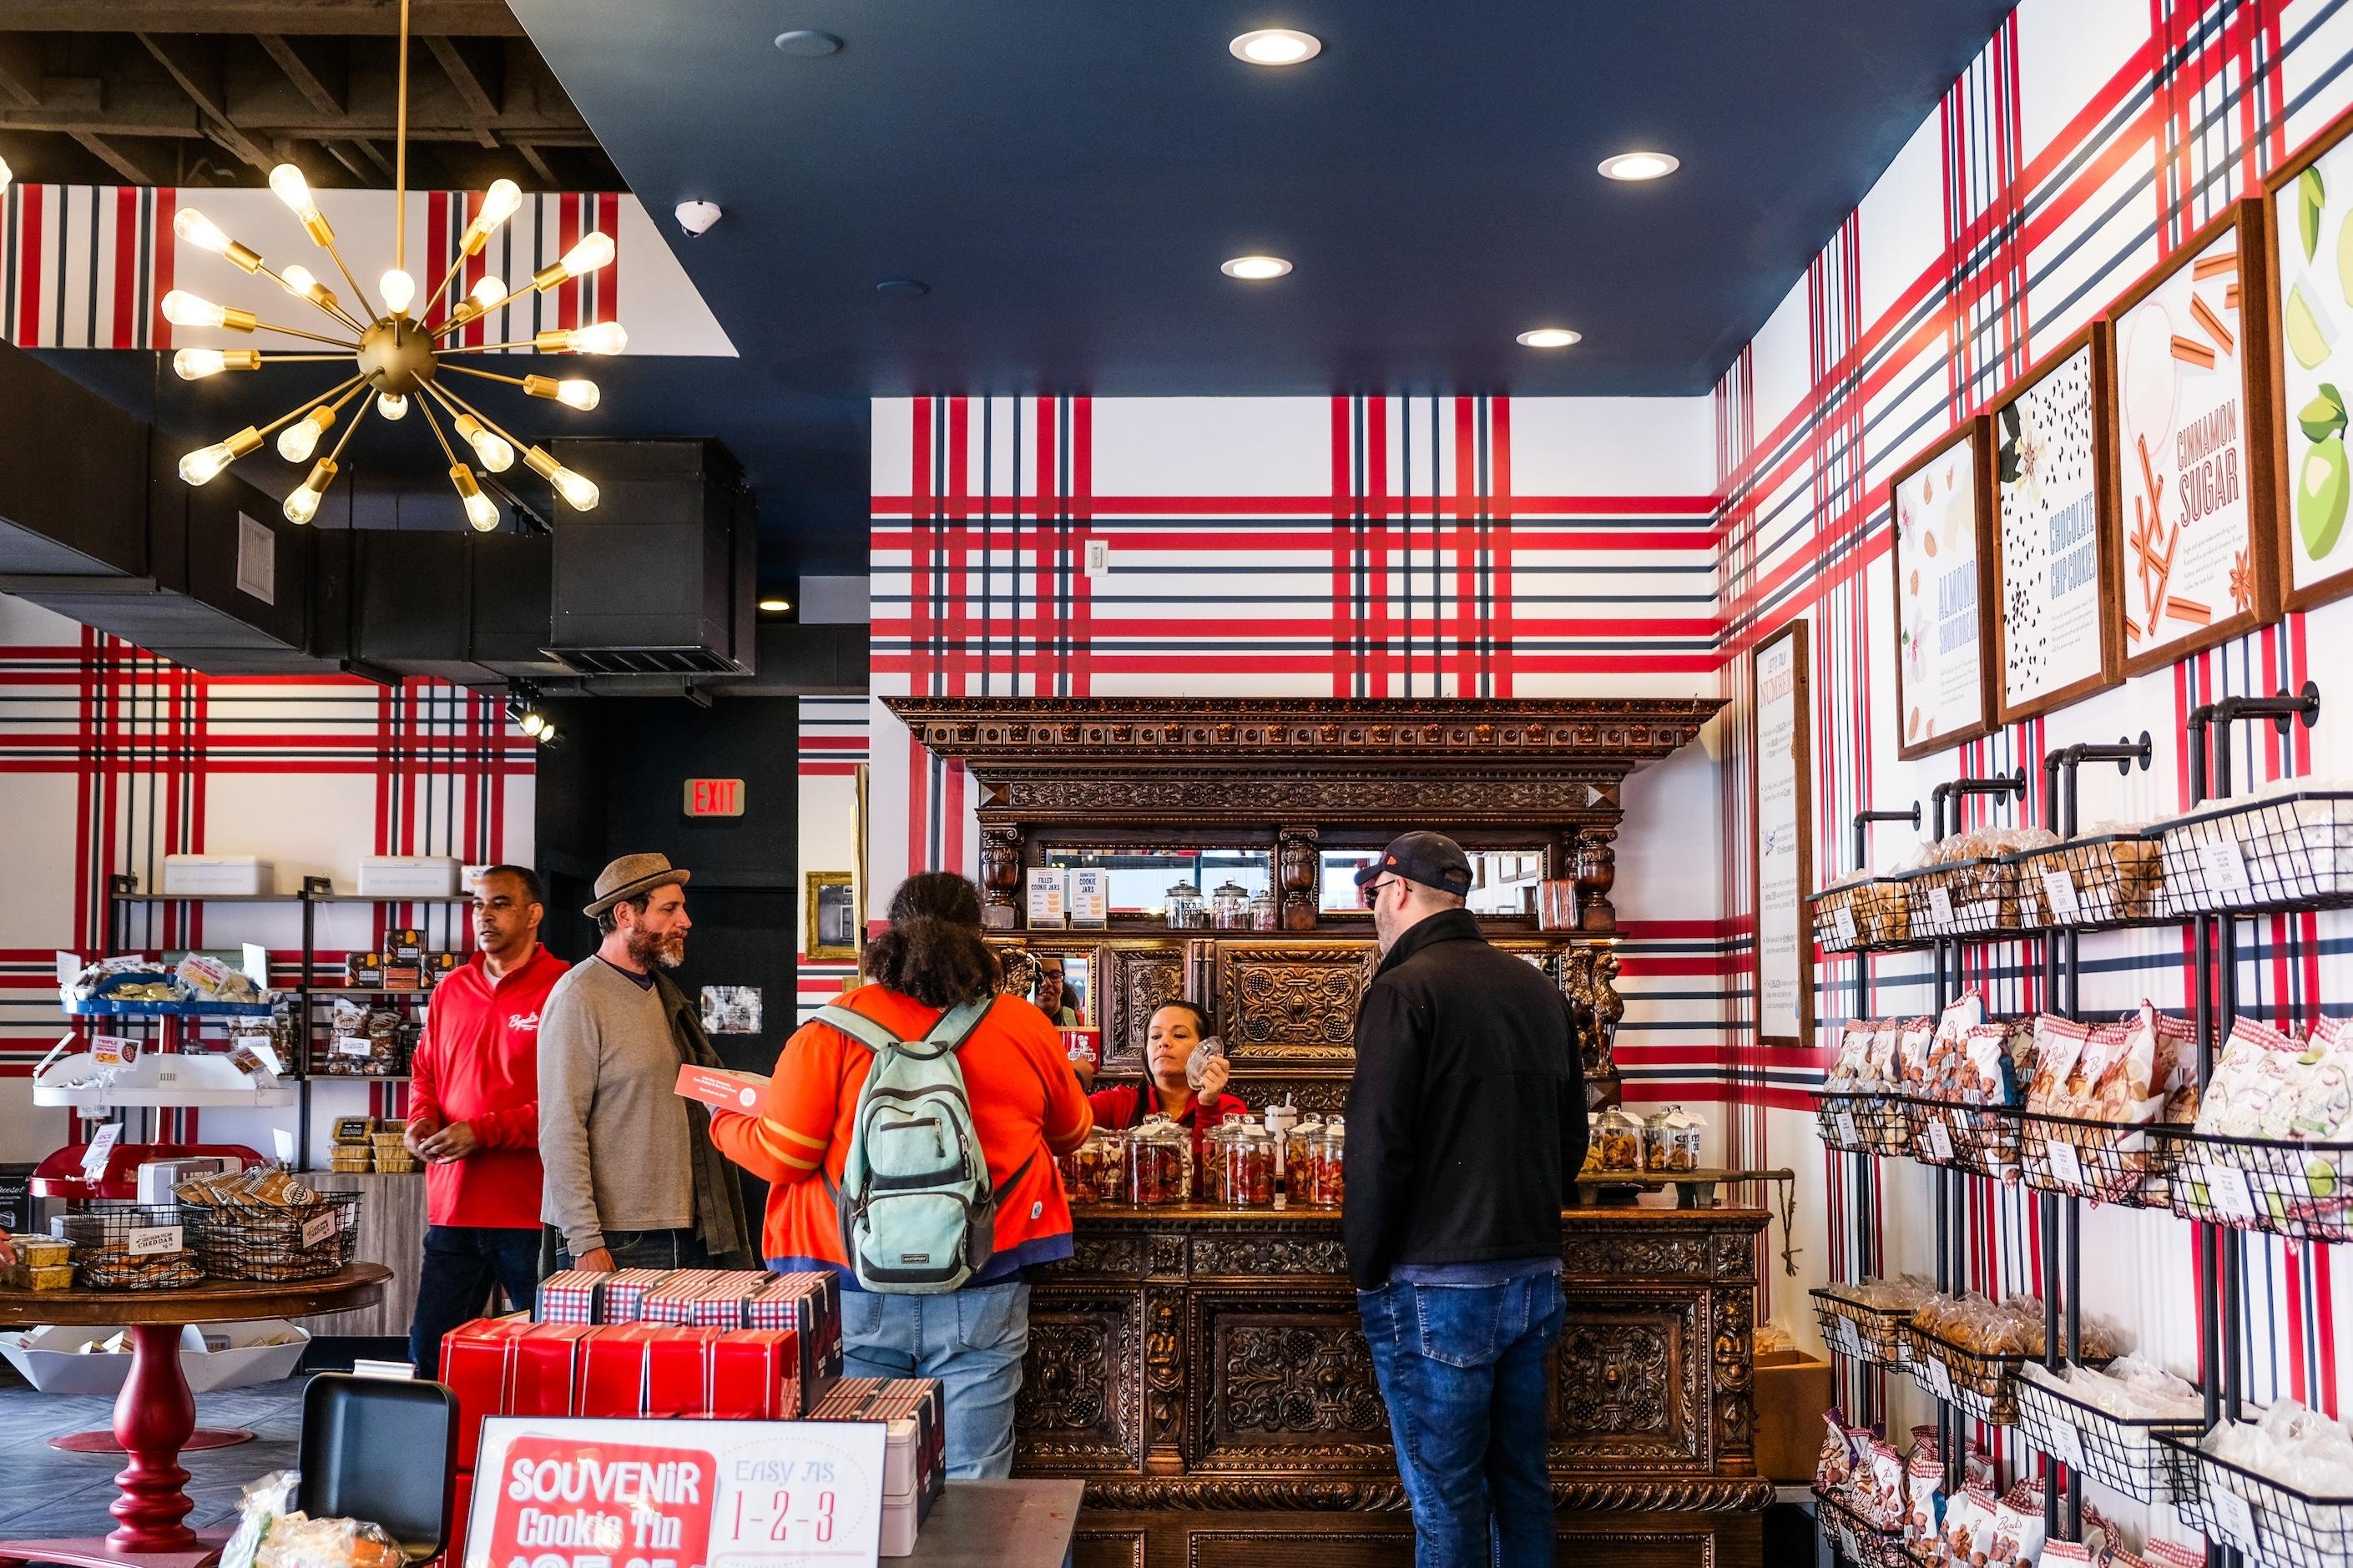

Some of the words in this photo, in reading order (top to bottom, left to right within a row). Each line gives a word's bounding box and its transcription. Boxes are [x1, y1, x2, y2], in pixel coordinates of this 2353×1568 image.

[2177, 399, 2237, 471] CINNAMON
[2179, 446, 2239, 528] SUGAR
[2049, 491, 2094, 555] CHOCOLATE
[1938, 560, 1977, 621] ALMOND
[2051, 555, 2067, 600] CHIP
[2068, 539, 2096, 590] COOKIES
[1939, 608, 1977, 656] SHORTBREAD
[694, 781, 737, 814] EXIT
[138, 1237, 173, 1248] CHEDDAR
[735, 1460, 795, 1486] EASY
[802, 1460, 835, 1483] AS
[631, 1510, 682, 1550] Tin
